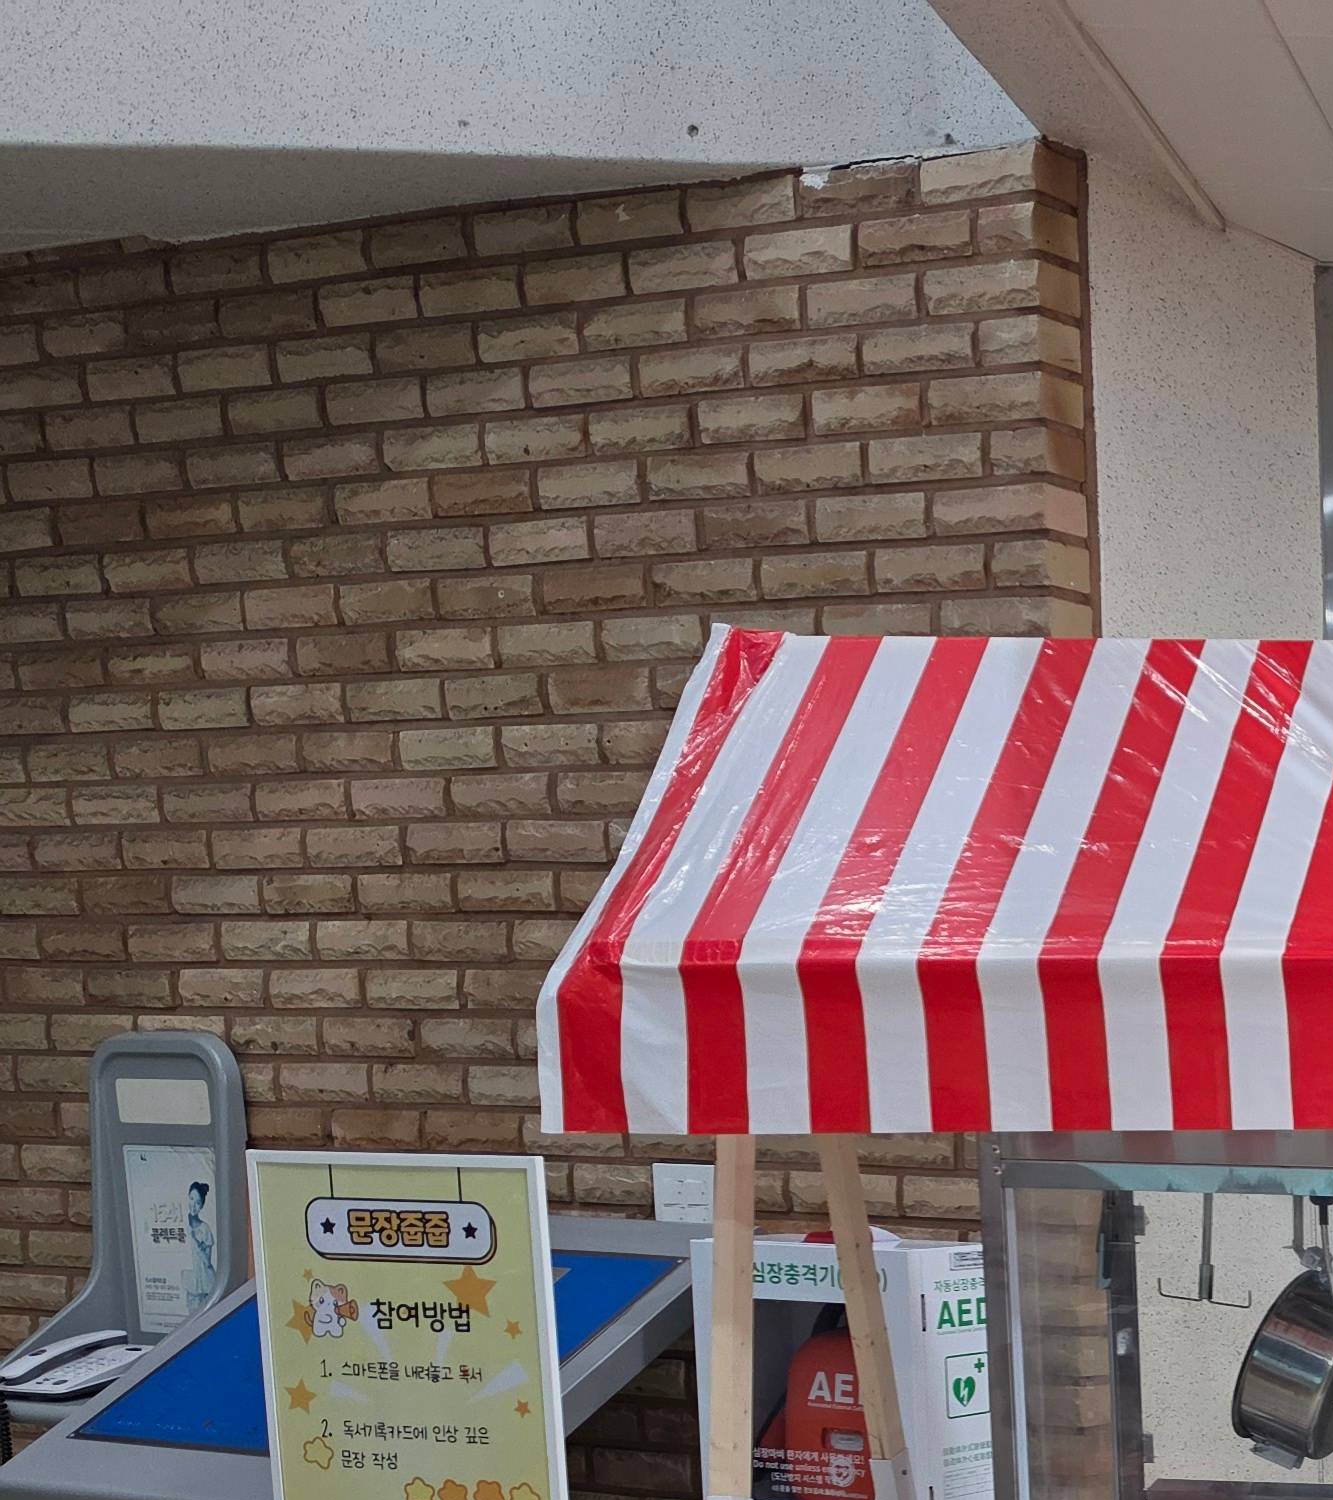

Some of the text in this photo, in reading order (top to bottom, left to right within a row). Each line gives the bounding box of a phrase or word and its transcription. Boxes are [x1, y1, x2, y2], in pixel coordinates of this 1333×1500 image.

[347, 1208, 451, 1248] 문장줍줍
[371, 1299, 471, 1333] 참여방법
[320, 1359, 483, 1383] 1. 스마트폰을 내려놓고 독서
[808, 1371, 864, 1405] AE
[321, 1418, 490, 1445] 2. 독서기록카드에 인상 깊은
[341, 1450, 399, 1471] 문장 작성
